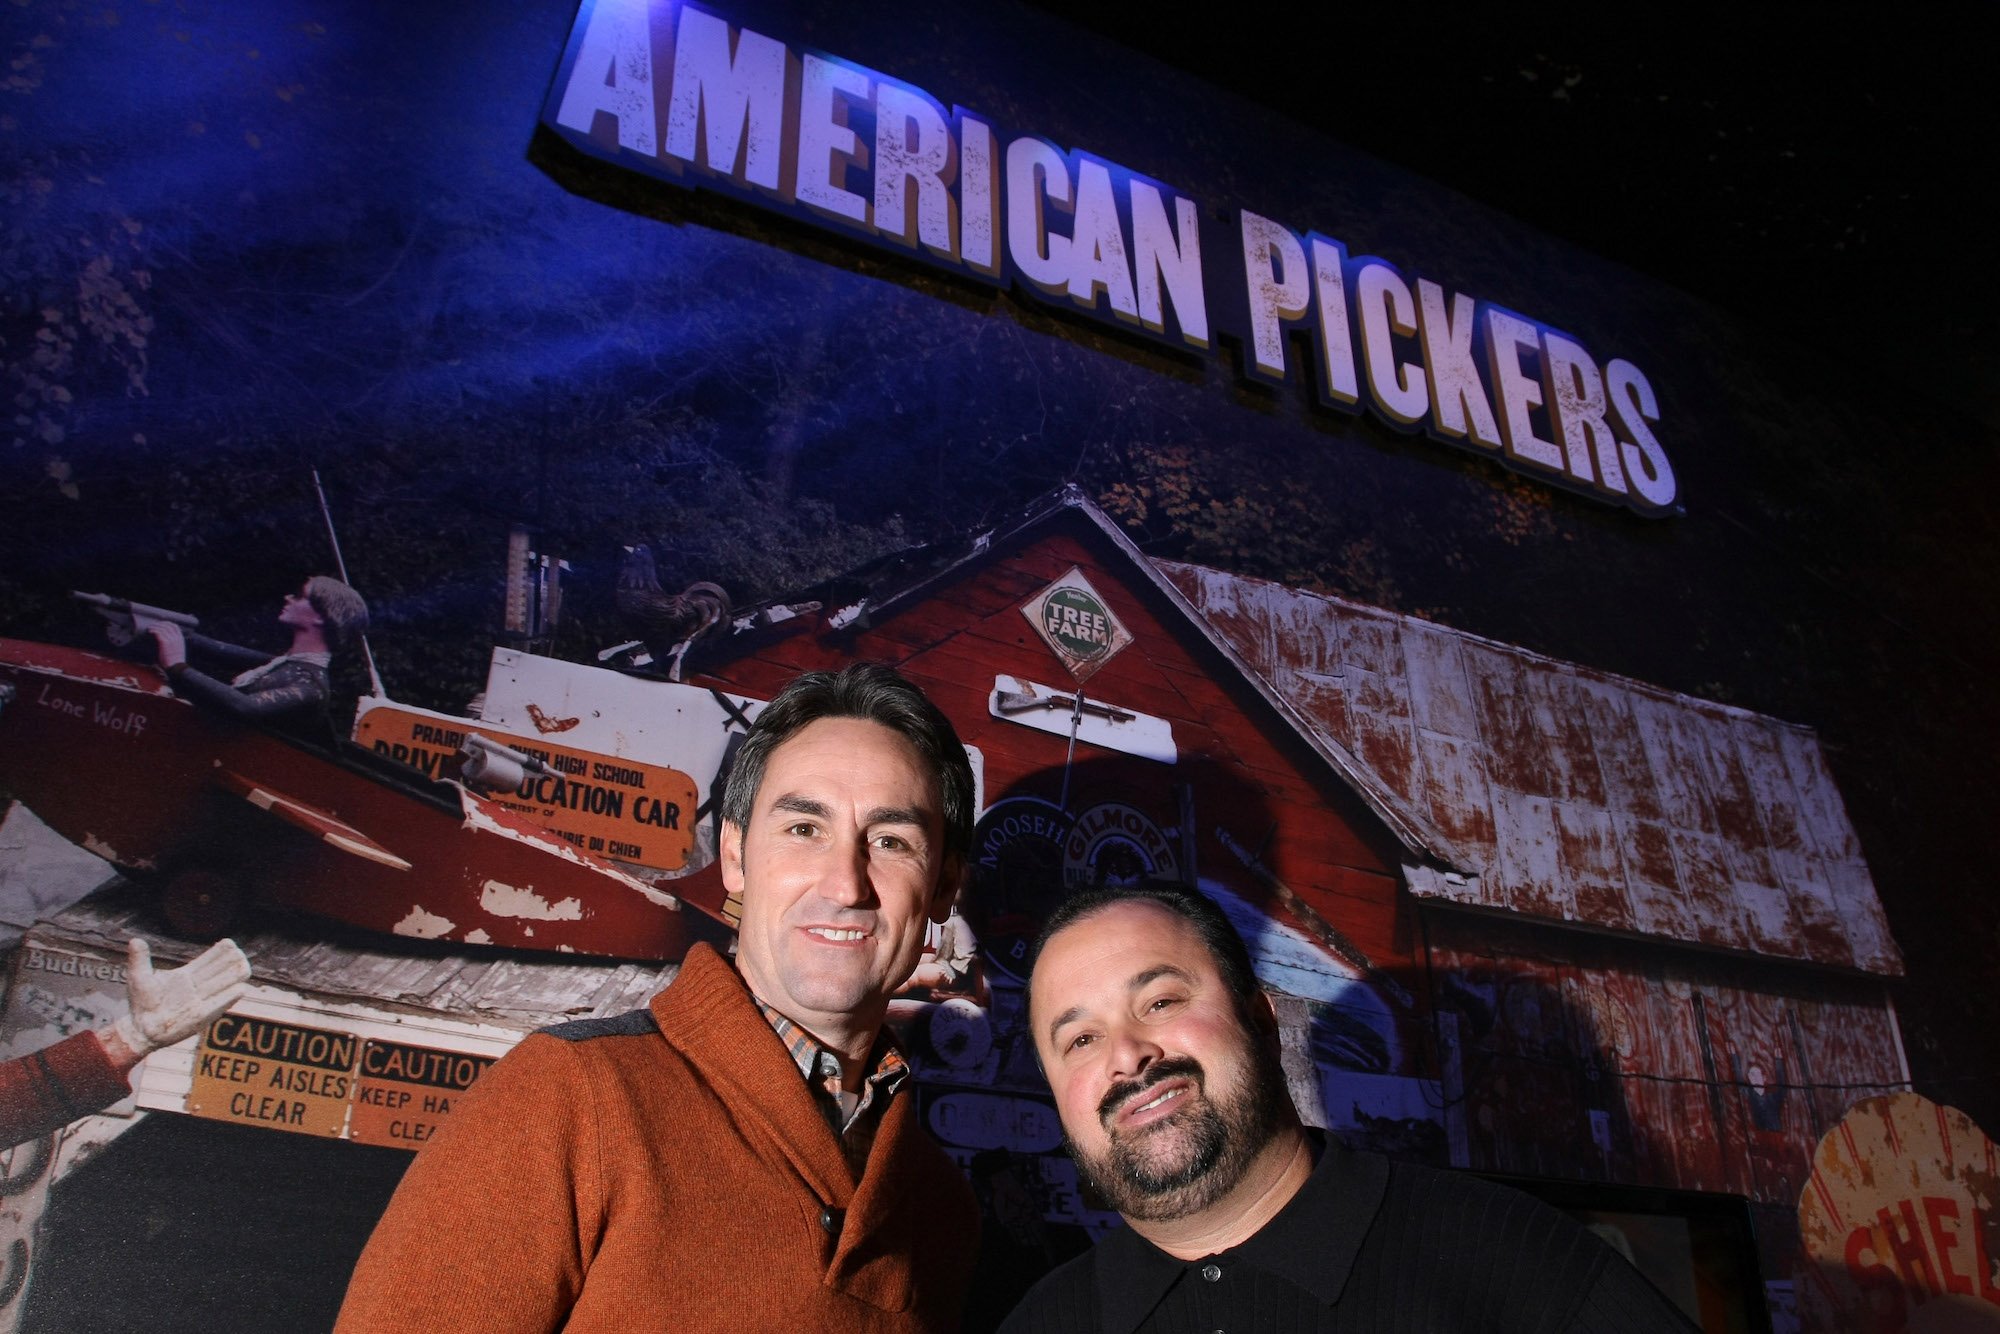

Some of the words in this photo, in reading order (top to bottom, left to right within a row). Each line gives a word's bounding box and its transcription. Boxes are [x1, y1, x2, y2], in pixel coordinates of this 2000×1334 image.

[556, 0, 1209, 348] AMERICAN
[1240, 208, 1678, 507] PICKERS
[1048, 617, 1107, 646] FARM
[1049, 602, 1105, 631] TREE
[37, 683, 86, 718] Lone
[94, 701, 147, 736] Wolf
[412, 723, 465, 749] PRAIRI
[553, 754, 587, 777] HIGH
[593, 762, 646, 789] SCHOOL
[515, 773, 624, 819] UCATION
[633, 796, 680, 830] CAR
[588, 836, 605, 852] DU
[609, 840, 642, 859] CHIEN
[979, 814, 1066, 869] MOOSEH
[1068, 808, 1174, 873] GILMORE
[26, 949, 129, 985] Budweis
[212, 1017, 352, 1068] CAUTION
[200, 1053, 260, 1083] KEEP
[269, 1066, 348, 1099] AISLES
[231, 1092, 306, 1126] CLEAR
[360, 1086, 412, 1109] KEEP
[423, 1095, 457, 1115] HA
